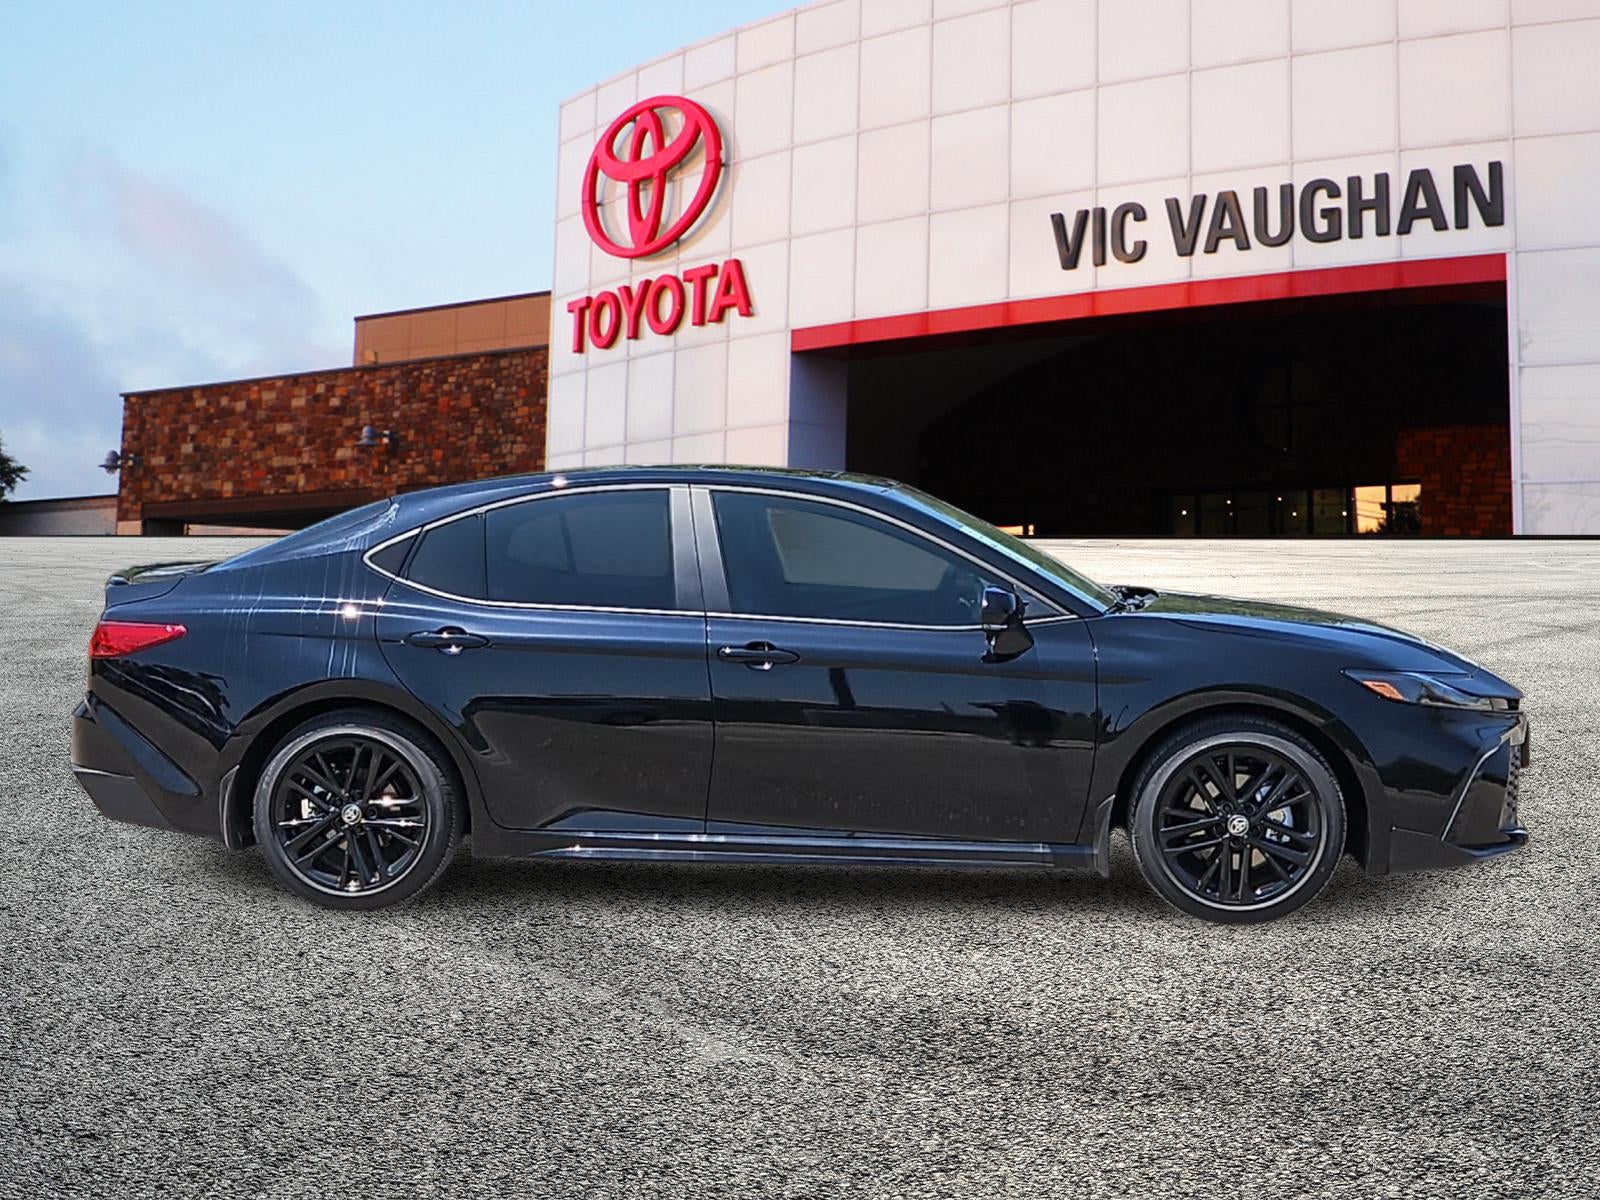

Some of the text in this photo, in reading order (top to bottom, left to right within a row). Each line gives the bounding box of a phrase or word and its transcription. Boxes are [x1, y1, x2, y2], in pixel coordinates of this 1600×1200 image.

[1050, 160, 1505, 271] VIC VAUGHAN
[567, 258, 754, 354] TOYOTA
